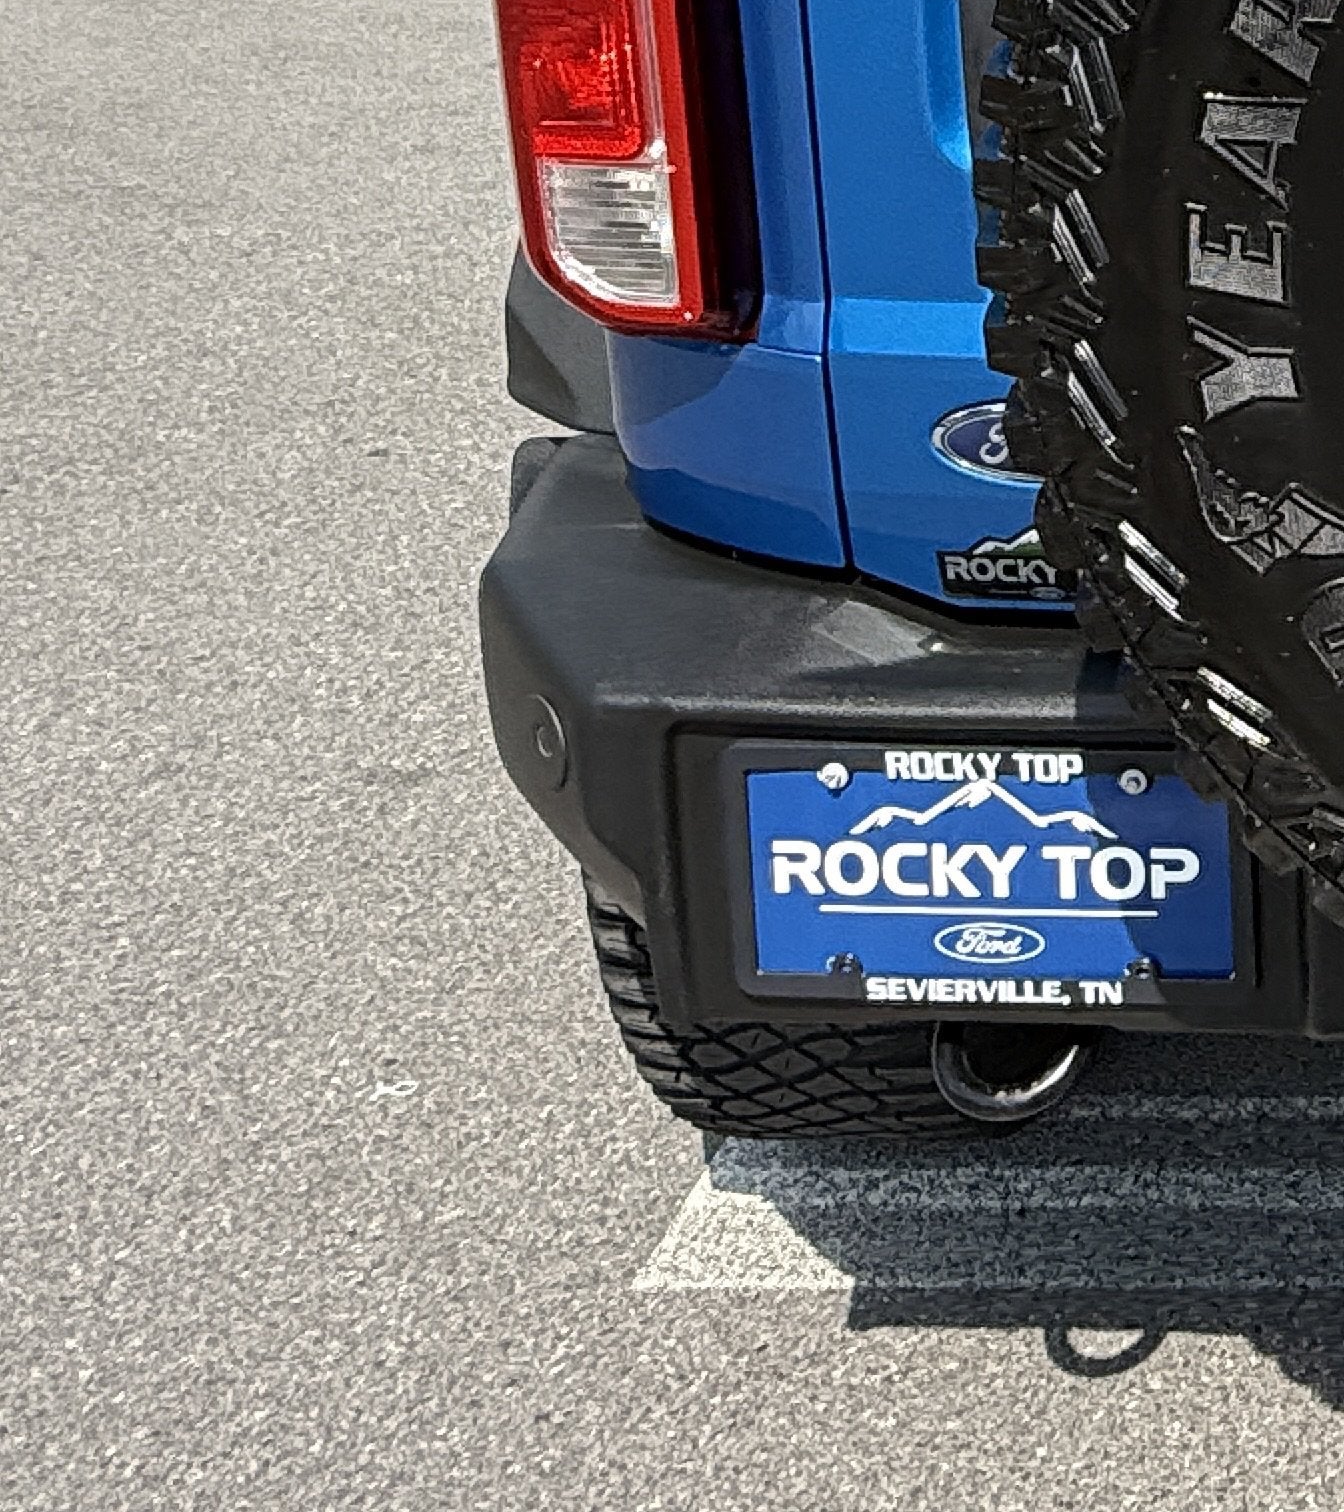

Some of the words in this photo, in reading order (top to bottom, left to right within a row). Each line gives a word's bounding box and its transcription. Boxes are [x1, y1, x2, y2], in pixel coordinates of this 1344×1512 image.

[944, 555, 1057, 585] ROCKY
[884, 750, 1002, 783] ROCKY
[1012, 752, 1085, 784] TOP
[770, 839, 1028, 899] ROCKY
[1041, 845, 1202, 901] TOP
[955, 927, 1022, 957] Ford
[865, 976, 1072, 1007] SEVIERVILLE,
[1079, 980, 1124, 1006] TN
